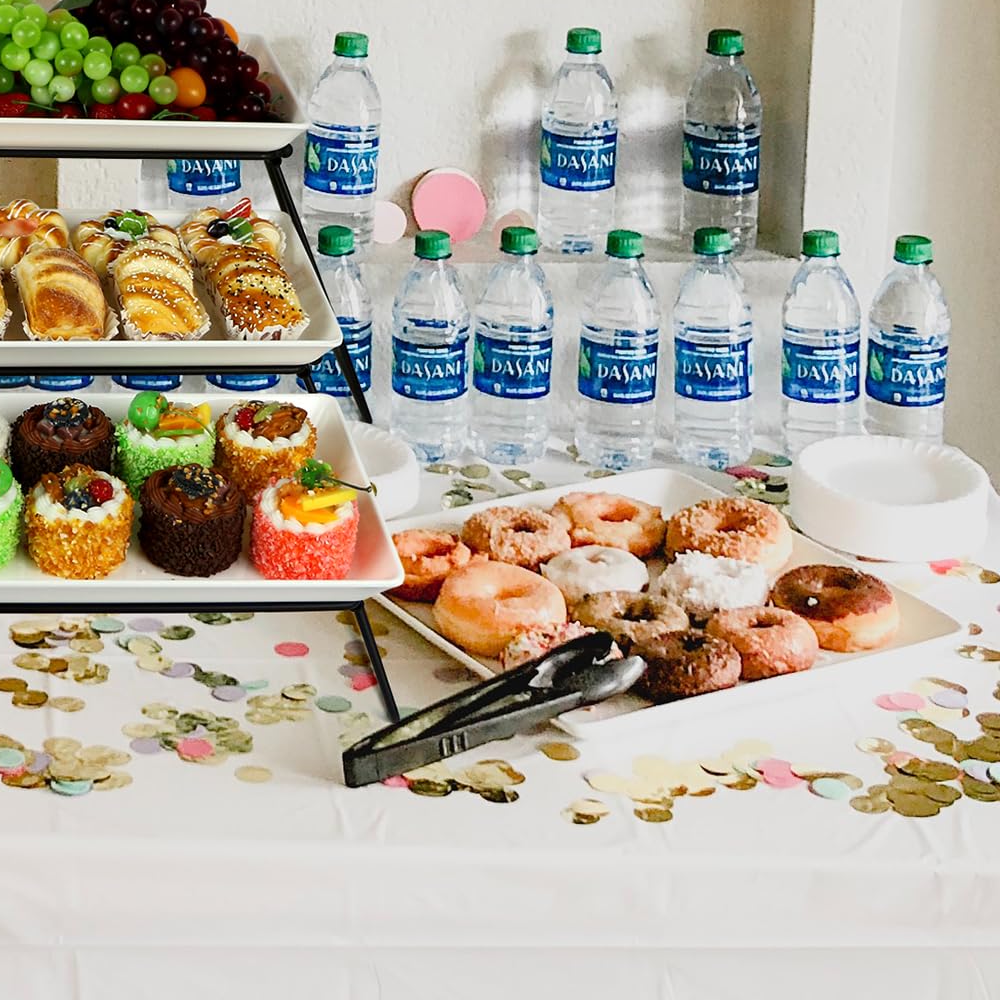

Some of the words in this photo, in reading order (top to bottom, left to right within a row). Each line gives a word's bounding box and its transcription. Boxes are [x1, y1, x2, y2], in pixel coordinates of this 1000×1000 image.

[182, 159, 237, 177] DASANI
[327, 155, 377, 176] DASAN
[557, 151, 614, 173] DASANI
[700, 155, 757, 176] DASANI
[311, 355, 369, 376] DASNI
[401, 359, 461, 381] DASANI
[491, 357, 549, 380] DASANI
[597, 362, 655, 384] DASANI
[682, 359, 744, 381] DASANI
[797, 361, 857, 384] DASANI
[891, 365, 946, 387] DASAN
